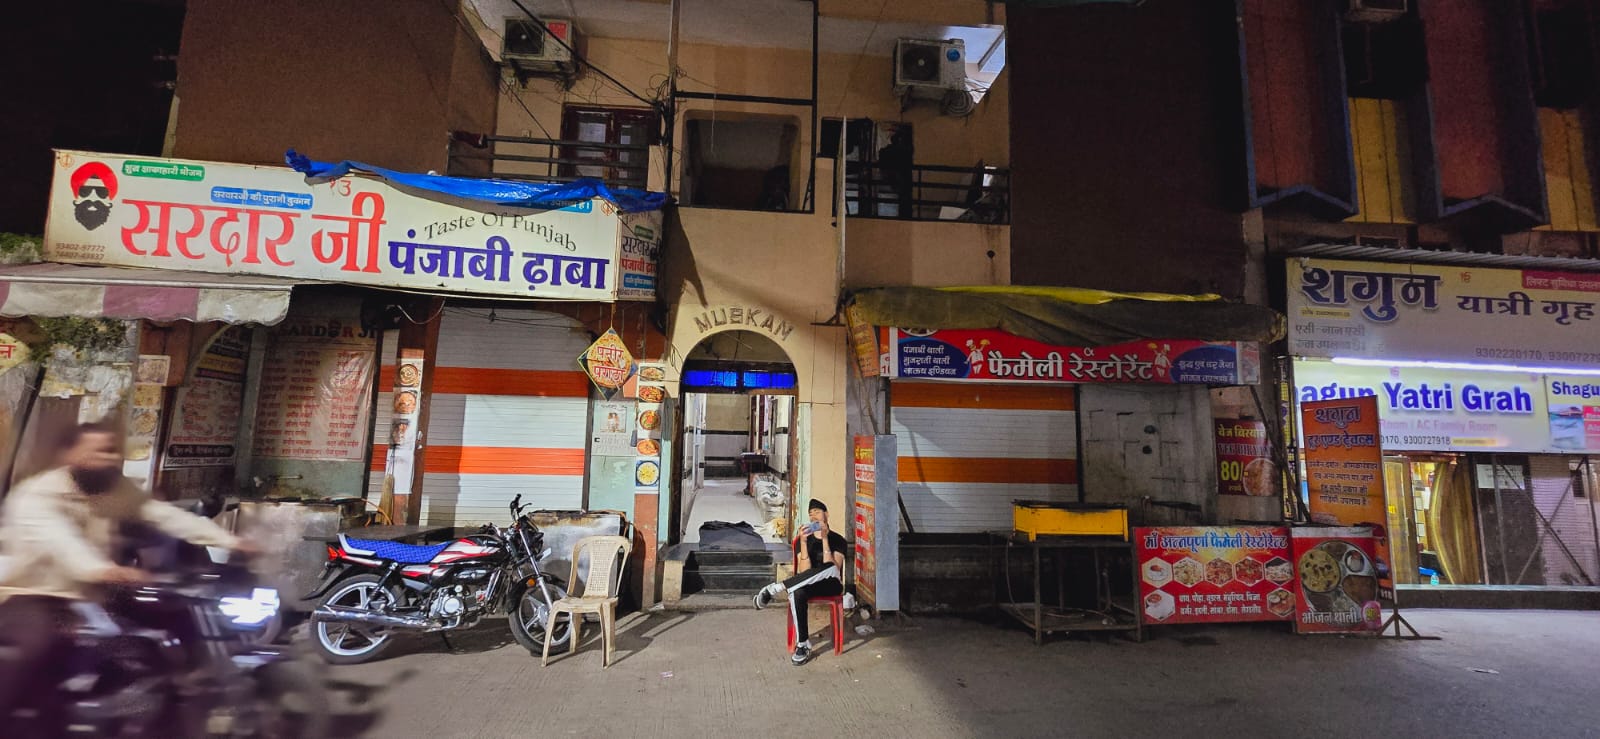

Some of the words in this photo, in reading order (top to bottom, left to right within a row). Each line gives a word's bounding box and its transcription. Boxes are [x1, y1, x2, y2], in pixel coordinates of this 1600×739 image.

[121, 199, 302, 267] सरदार
[311, 192, 387, 274] जी
[424, 213, 475, 240] Taste
[482, 211, 507, 229] Of
[511, 215, 578, 252] Punjab
[388, 229, 513, 282] पंजाबी
[1302, 267, 1441, 322] शगुन
[1456, 291, 1534, 316] यात्री
[1541, 300, 1595, 325] गृह
[693, 307, 795, 341] MUSKAN
[904, 344, 926, 354] पंजाबी
[927, 345, 944, 354] थाली
[988, 350, 1064, 378] फैमेली
[1069, 353, 1153, 379] रेस्टोरेंट
[1383, 381, 1453, 411] Yatri
[1462, 384, 1533, 412] Grah
[1218, 424, 1232, 437] वेज
[1315, 406, 1361, 428] शगुन
[1416, 419, 1432, 431] AC
[1469, 420, 1498, 432] Room
[1210, 532, 1242, 550] फैमेली
[1302, 609, 1332, 625] भोजन
[1334, 607, 1357, 623] थाली
